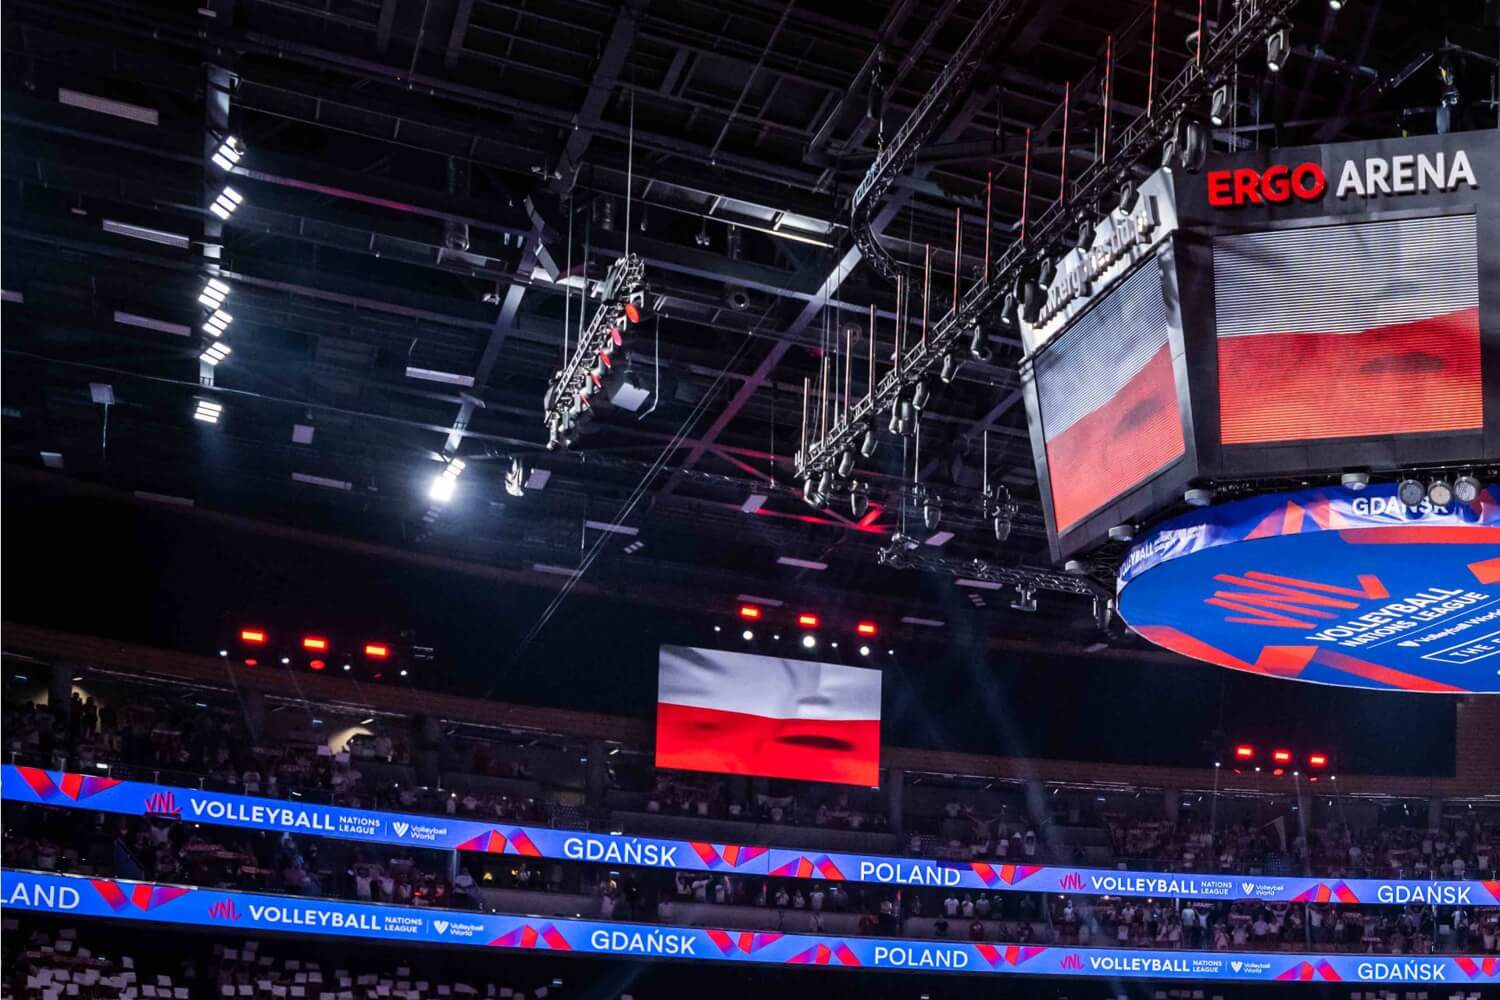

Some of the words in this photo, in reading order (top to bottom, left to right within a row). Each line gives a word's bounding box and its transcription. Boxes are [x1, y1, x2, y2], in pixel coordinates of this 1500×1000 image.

[1207, 161, 1326, 207] ERGO
[1336, 149, 1478, 198] ARENA
[1306, 586, 1466, 644] VOLLEYBALL
[1338, 618, 1418, 648] NATIONS
[1412, 590, 1490, 623] LEAGUE
[1450, 638, 1493, 659] THE
[190, 797, 335, 832] VOLLEYBALL
[339, 815, 381, 828] NATIONS
[338, 823, 376, 835] LEAGUE
[410, 824, 448, 836] Volleyball
[410, 831, 437, 842] World
[562, 836, 679, 868] GDAŃSK
[860, 861, 961, 888] POLAND
[1090, 874, 1199, 895] VOLLEYBALL
[1200, 880, 1233, 890] NATIONS
[2, 881, 80, 912] AND
[1200, 887, 1232, 896] LEAGUE
[1376, 883, 1472, 905] GDAŃSK
[248, 904, 382, 931] VOLLEYBALL
[384, 915, 423, 927] NATIONS
[384, 923, 418, 934] LEAGUE
[591, 929, 696, 956] GDAŃSK
[874, 947, 968, 970] POLAND
[1089, 955, 1191, 973] VOLLEYBALL
[1192, 958, 1223, 968] NATIONS
[1192, 965, 1220, 974] LEAGUE
[1357, 961, 1447, 982] GDAŃSK
